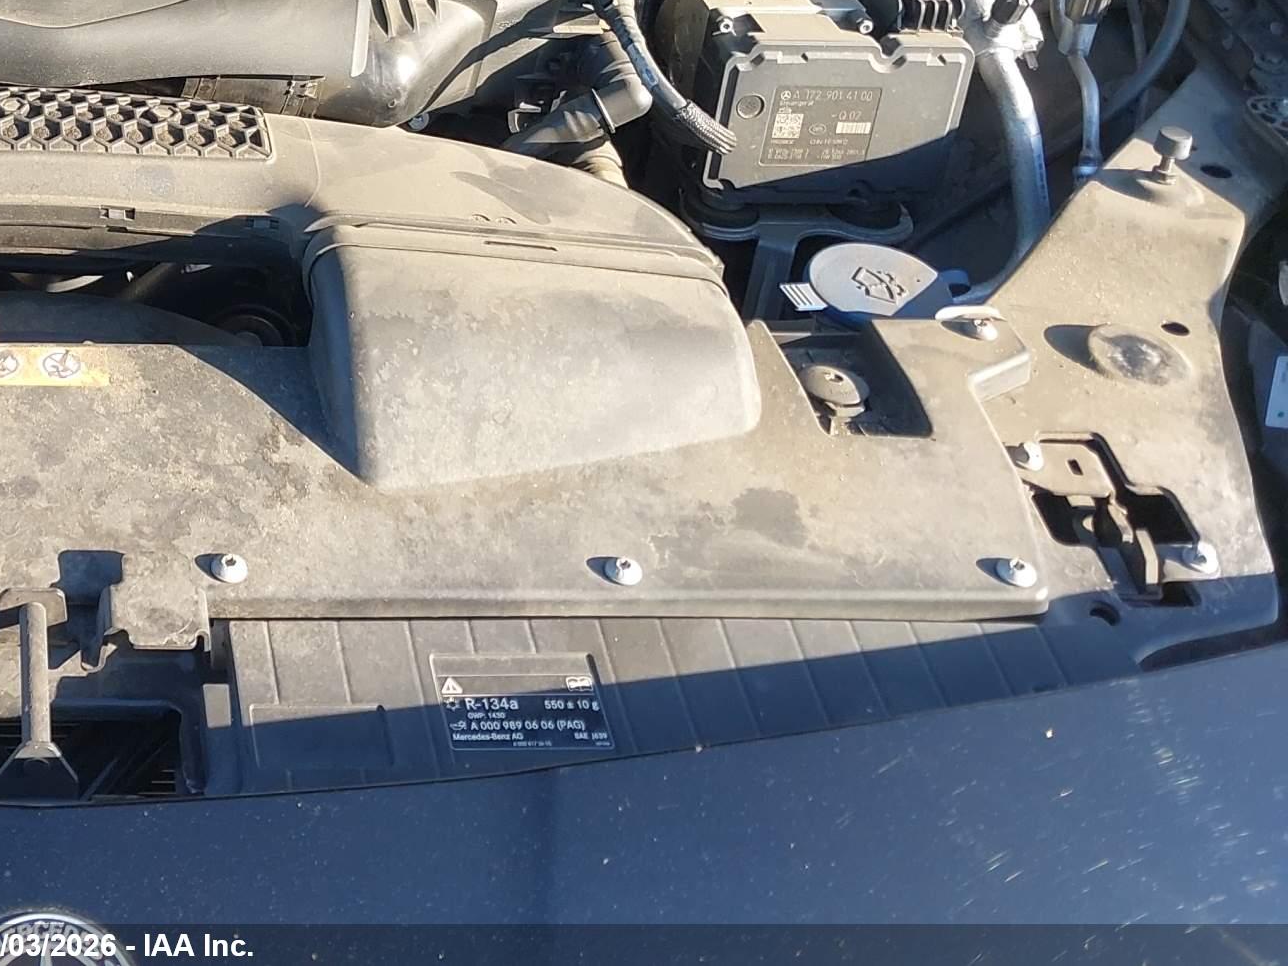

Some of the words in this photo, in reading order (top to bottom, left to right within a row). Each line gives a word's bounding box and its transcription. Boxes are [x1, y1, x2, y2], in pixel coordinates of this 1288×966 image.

[464, 697, 519, 710] R-134a
[544, 699, 565, 710] 550
[577, 699, 590, 709] 10
[470, 720, 479, 730] A
[480, 720, 501, 730] 000
[502, 720, 523, 730] 989
[524, 720, 539, 730] 06
[540, 720, 555, 730] 06
[556, 720, 586, 731] (PAG)
[452, 732, 511, 741] Mercedes-Benz
